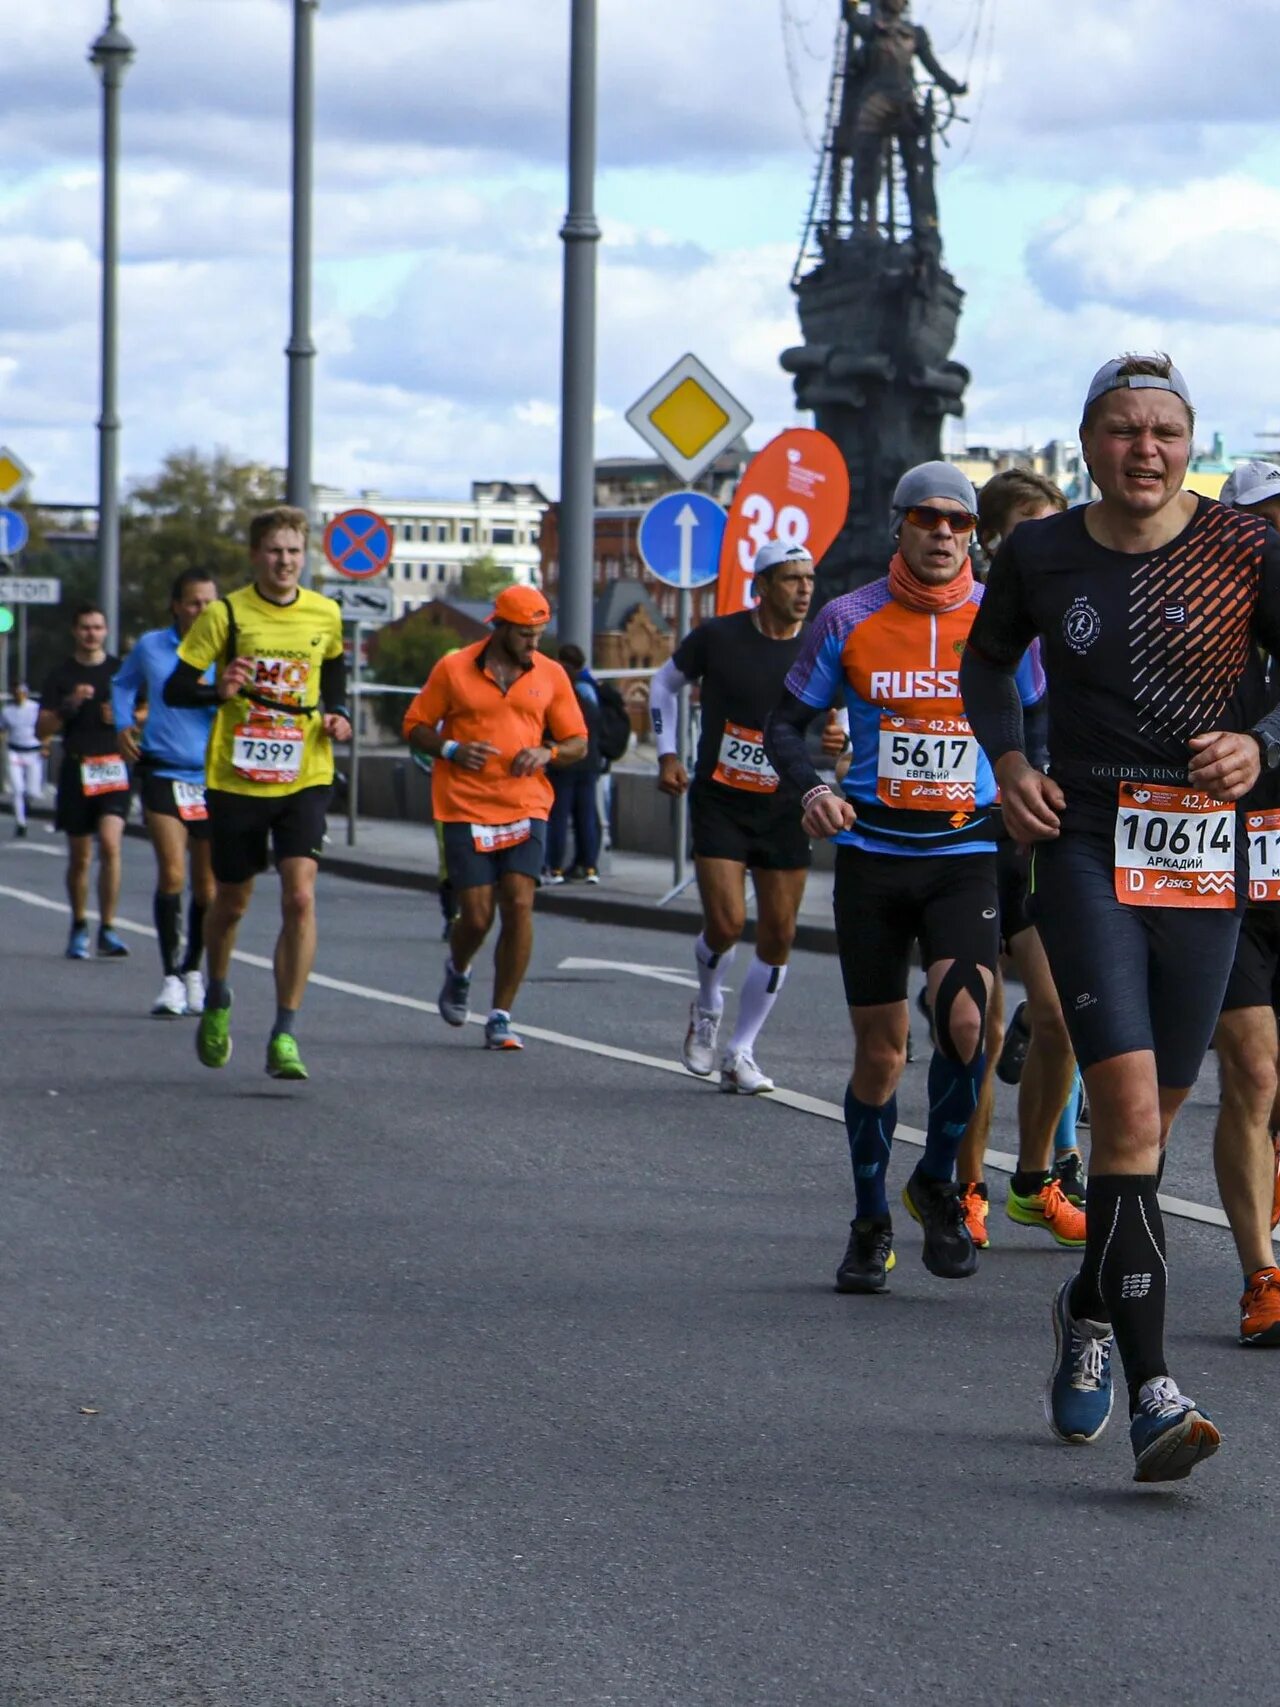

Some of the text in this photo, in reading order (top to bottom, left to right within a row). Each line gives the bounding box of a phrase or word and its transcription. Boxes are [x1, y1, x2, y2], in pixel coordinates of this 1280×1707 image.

[870, 671, 962, 699] RUSS
[928, 720, 955, 733] 42,2
[242, 740, 294, 762] 7399
[891, 736, 969, 769] 5617
[906, 769, 950, 780] ЕВГЕНИЙ
[1091, 766, 1185, 780] GOLDEN RING
[890, 780, 901, 797] E
[1123, 814, 1232, 855] 10614
[1147, 855, 1203, 870] АРКАДИЙ
[1130, 870, 1145, 892] D
[1166, 879, 1194, 889] asics
[1254, 881, 1268, 899] D
